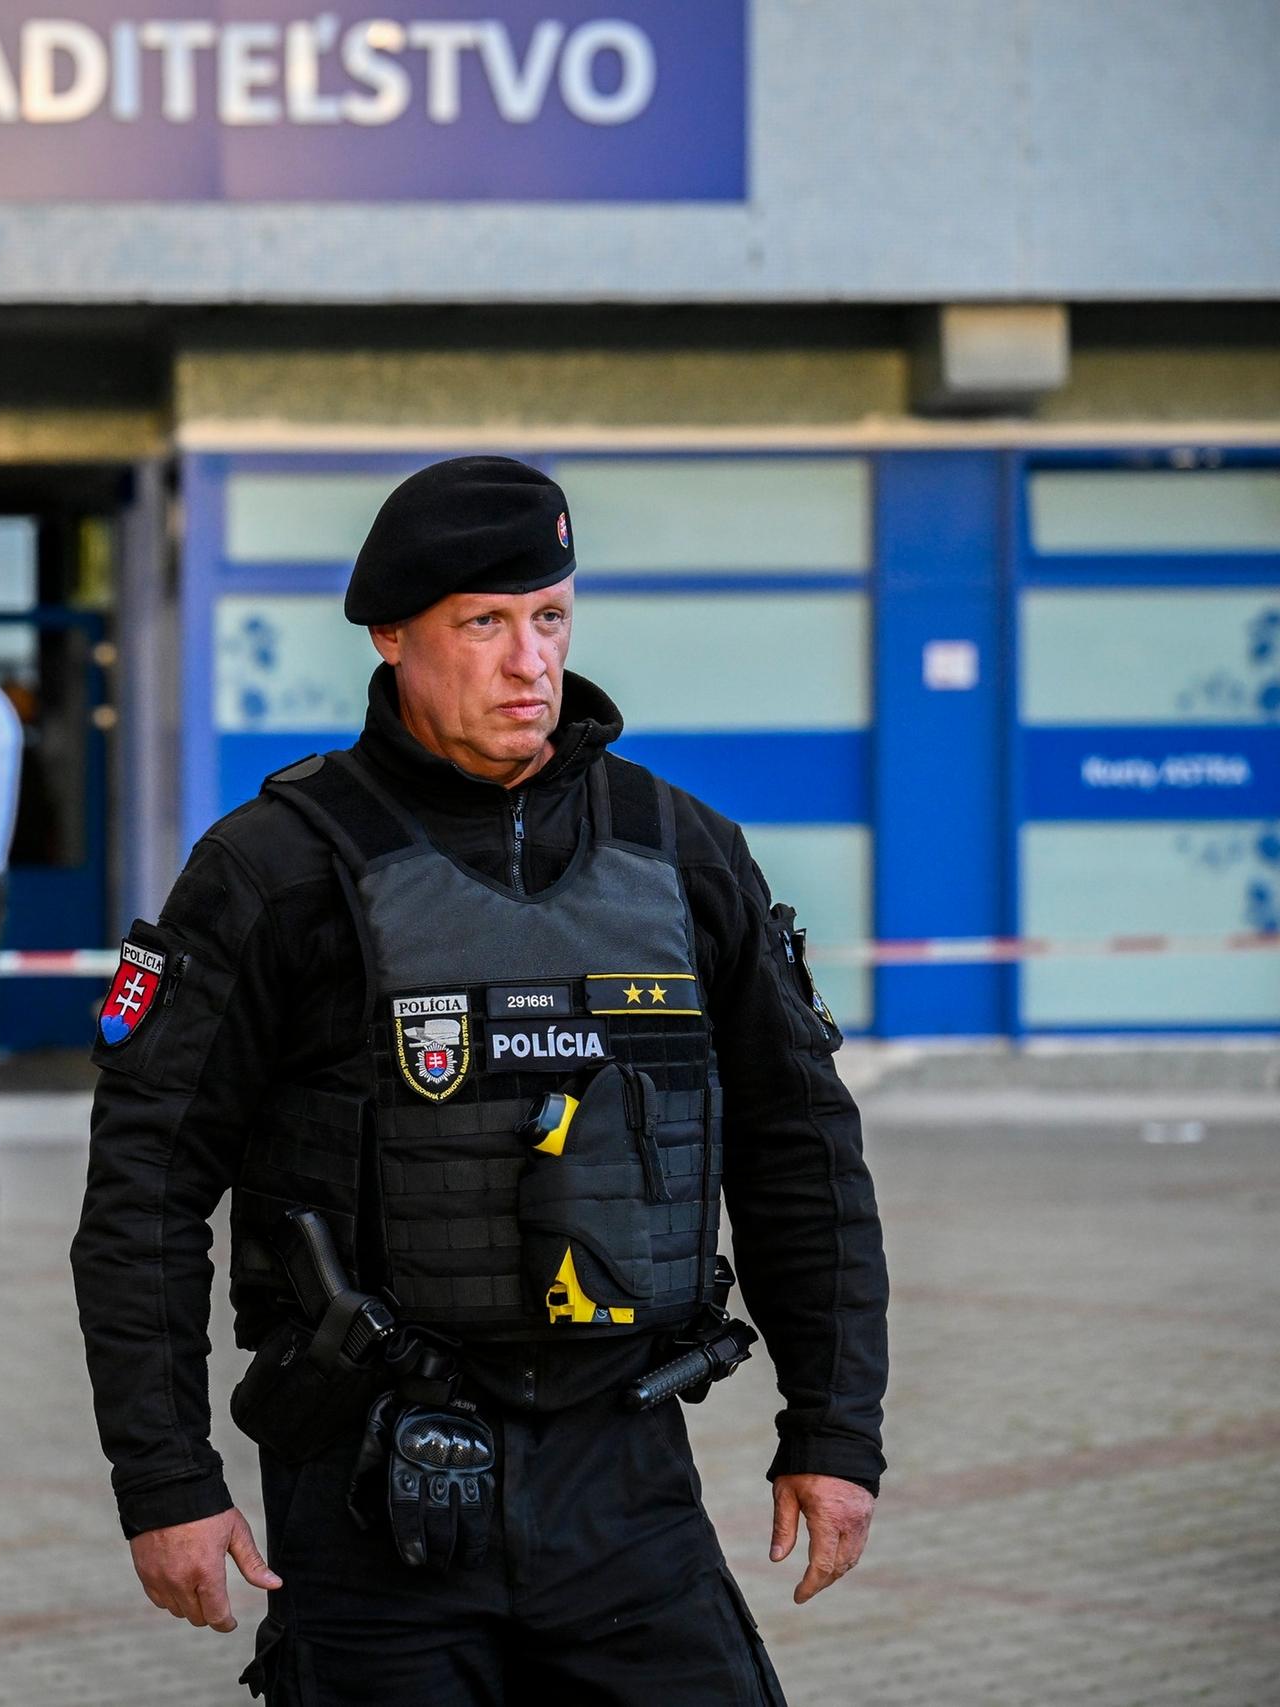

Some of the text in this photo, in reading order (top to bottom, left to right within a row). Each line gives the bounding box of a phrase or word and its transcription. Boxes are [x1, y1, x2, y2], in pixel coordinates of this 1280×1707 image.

[124, 946, 161, 971] POLÍCIA
[399, 998, 462, 1014] POLÍCIA
[507, 995, 554, 1008] 291681
[492, 1025, 605, 1059] POLÍCIA
